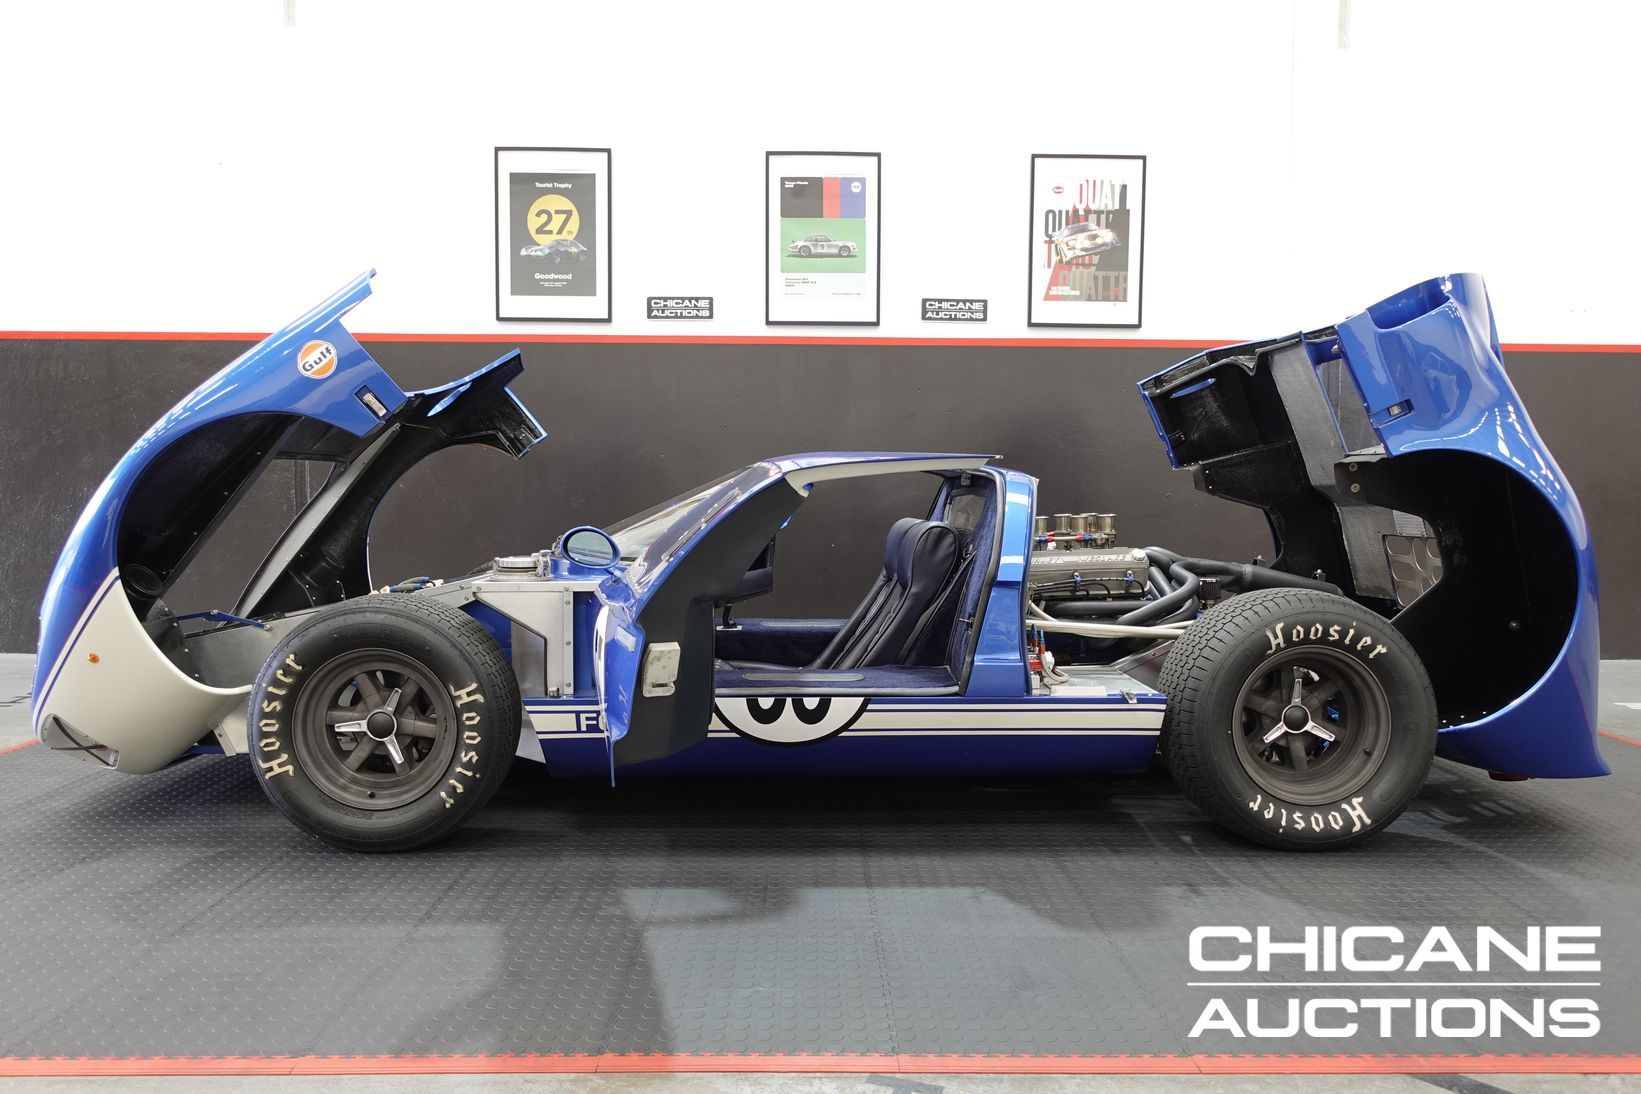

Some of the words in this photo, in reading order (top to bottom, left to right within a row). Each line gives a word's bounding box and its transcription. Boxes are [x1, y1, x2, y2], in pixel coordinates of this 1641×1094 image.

[534, 272, 573, 280] Goodwood
[651, 299, 710, 308] CHICANE
[925, 301, 984, 310] CHICANE
[651, 309, 710, 317] AUCTIONS
[925, 311, 984, 319] AUCTIONS
[302, 346, 332, 372] Gulf
[1265, 620, 1388, 660] Hoosier
[258, 653, 304, 780] Hoosier
[439, 681, 484, 809] Hoosier
[1248, 794, 1373, 834] Hoosier
